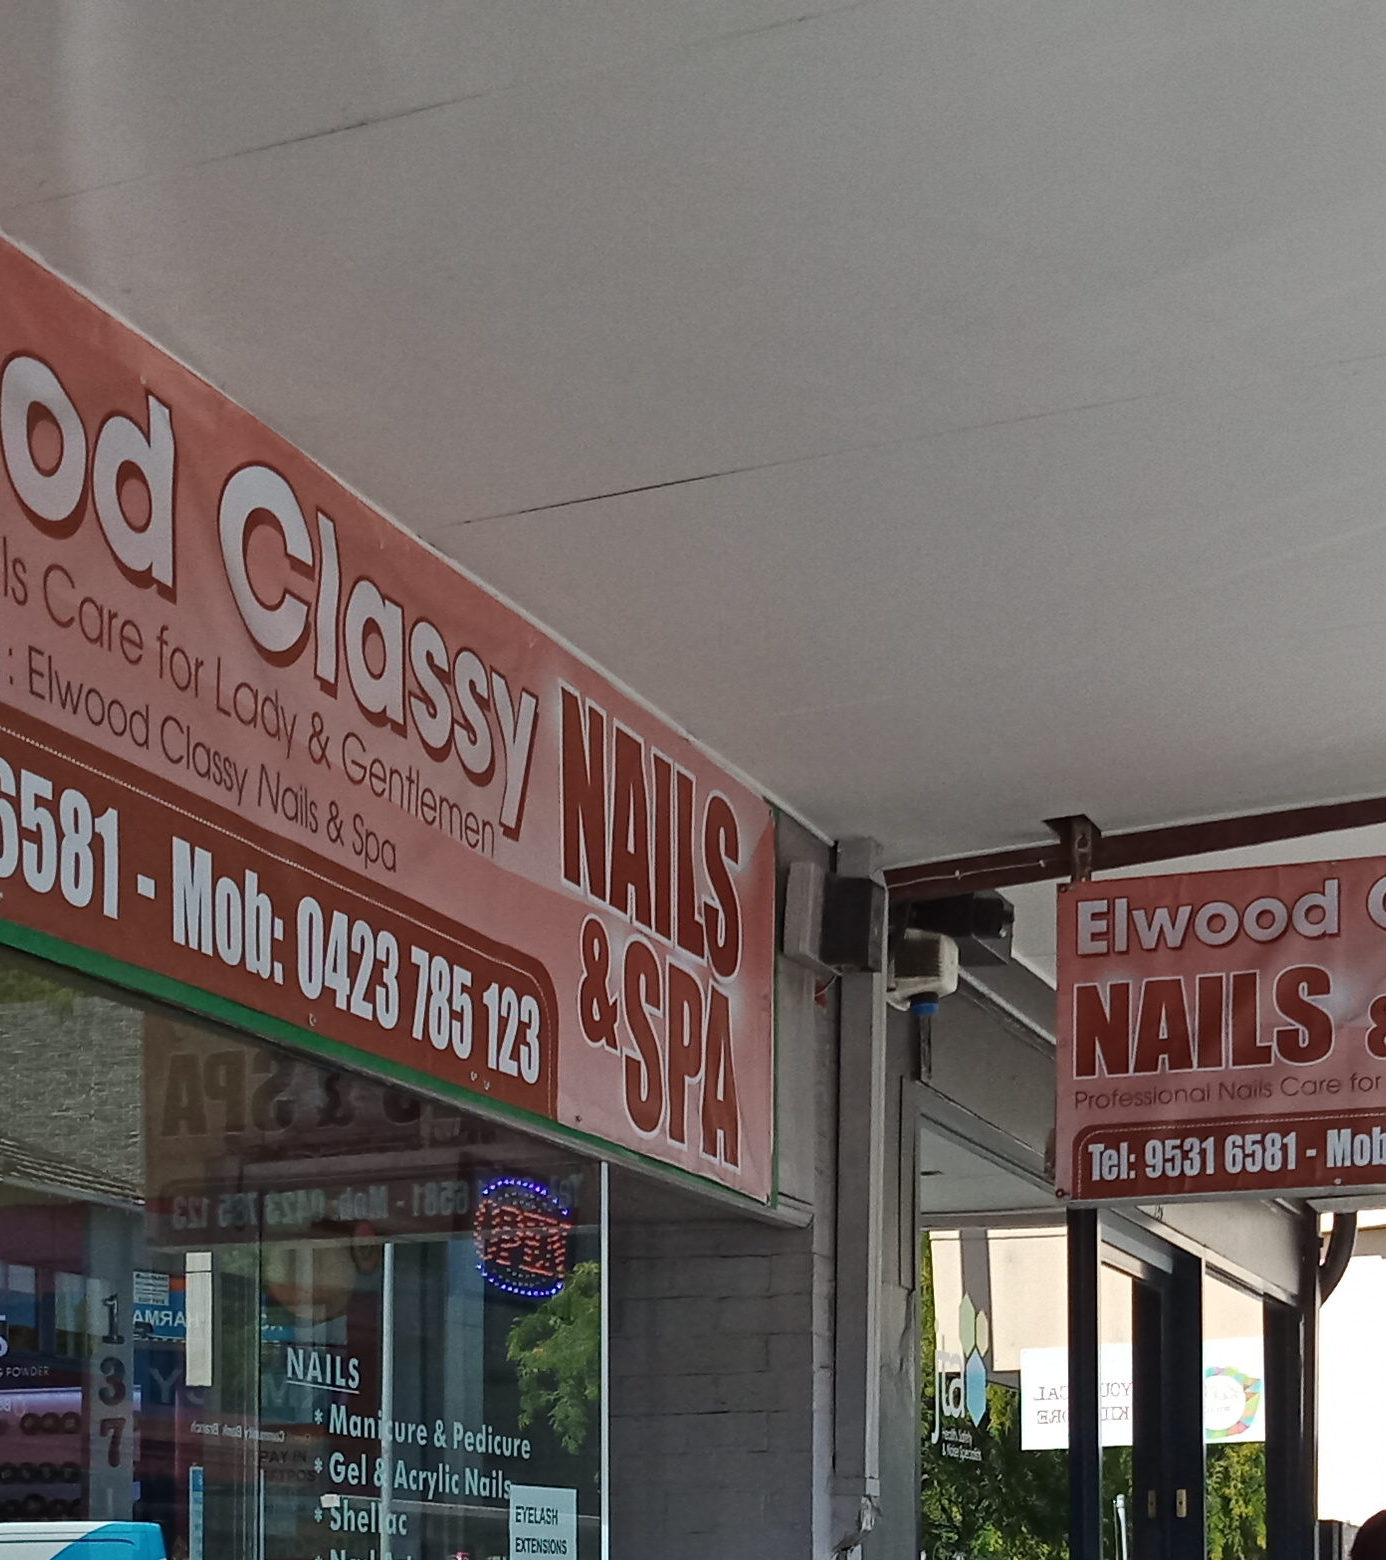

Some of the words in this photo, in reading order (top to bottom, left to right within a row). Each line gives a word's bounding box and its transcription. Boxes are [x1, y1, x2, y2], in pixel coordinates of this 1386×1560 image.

[216, 461, 538, 841] Classy
[42, 565, 144, 665] Care
[158, 622, 206, 690] for
[216, 661, 298, 753] Lady
[308, 720, 332, 768] &
[342, 731, 496, 859] Gentlemen
[28, 648, 150, 751] Elwood
[161, 715, 248, 805] Classy
[258, 764, 318, 835] Nails
[327, 800, 346, 838] &
[352, 815, 398, 873] Spa
[559, 681, 740, 986] NAILS
[1075, 877, 1341, 957] Elwood
[136, 873, 156, 900] -
[171, 835, 283, 985] Mob:
[297, 895, 400, 1030] 0423
[411, 945, 474, 1060] 785
[481, 981, 541, 1085] 123
[579, 914, 621, 1056] &
[622, 934, 740, 1173] SPA
[1073, 962, 1334, 1080] NAILS
[1074, 1085, 1212, 1111] Professional
[1218, 1080, 1273, 1101] Nails
[1281, 1075, 1341, 1097] Care
[1350, 1071, 1380, 1092] for
[1088, 1141, 1137, 1181] Tel:
[1144, 1136, 1215, 1177] 9531
[1224, 1131, 1297, 1173] 6581
[1306, 1146, 1317, 1158] -
[6, 1366, 49, 1378] POWDER
[287, 1347, 359, 1389] NAILS
[329, 1404, 427, 1446] Manicure
[433, 1420, 447, 1447] &
[453, 1422, 531, 1461] Pedicure
[329, 1452, 367, 1486] Gel
[394, 1461, 459, 1500] Acrylic
[465, 1472, 511, 1500] Nails
[515, 1504, 559, 1526] EYELASH
[515, 1537, 567, 1556] EXTENSIONS
